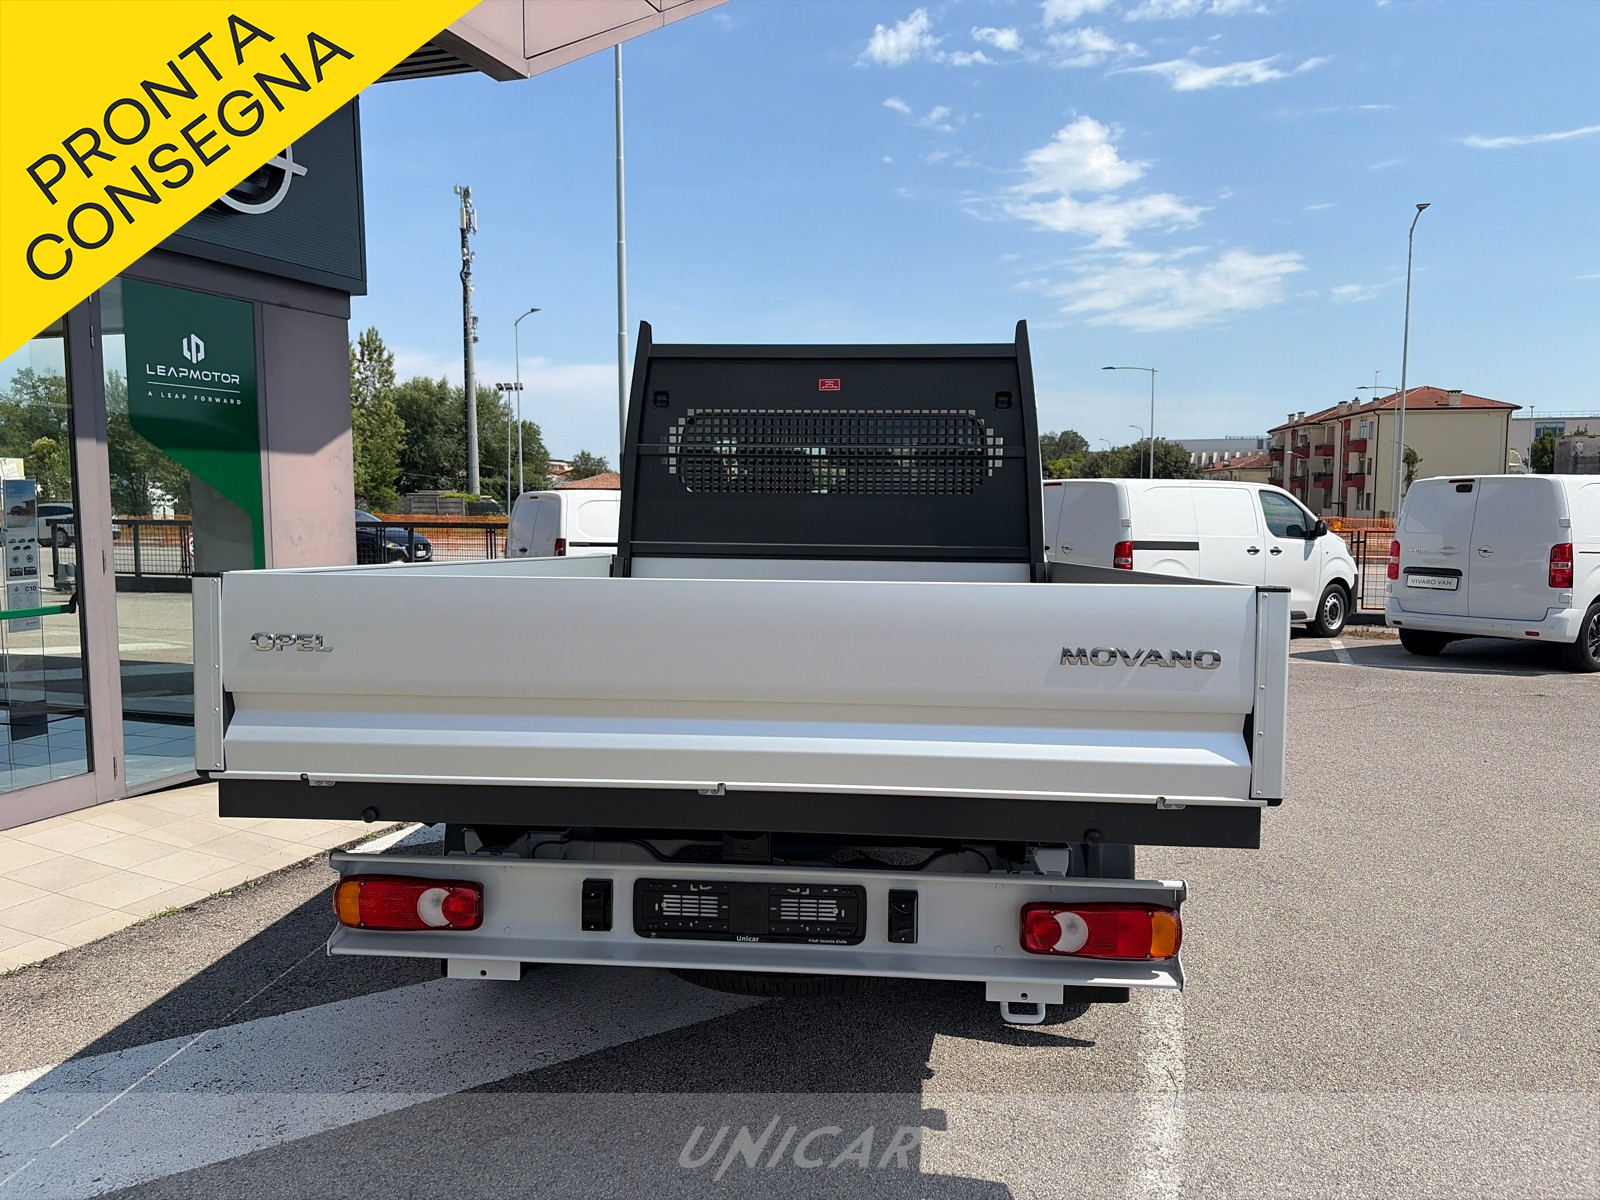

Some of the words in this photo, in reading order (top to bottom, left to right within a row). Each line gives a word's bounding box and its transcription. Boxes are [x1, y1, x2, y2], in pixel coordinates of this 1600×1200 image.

[146, 363, 241, 385] LEAPMOTOR
[160, 391, 187, 400] LEAP
[194, 395, 242, 406] FORWARD
[1410, 578, 1437, 586] VIVARO
[249, 632, 335, 653] OPEL
[1059, 645, 1223, 670] MOVANO
[736, 935, 760, 943] Unicar
